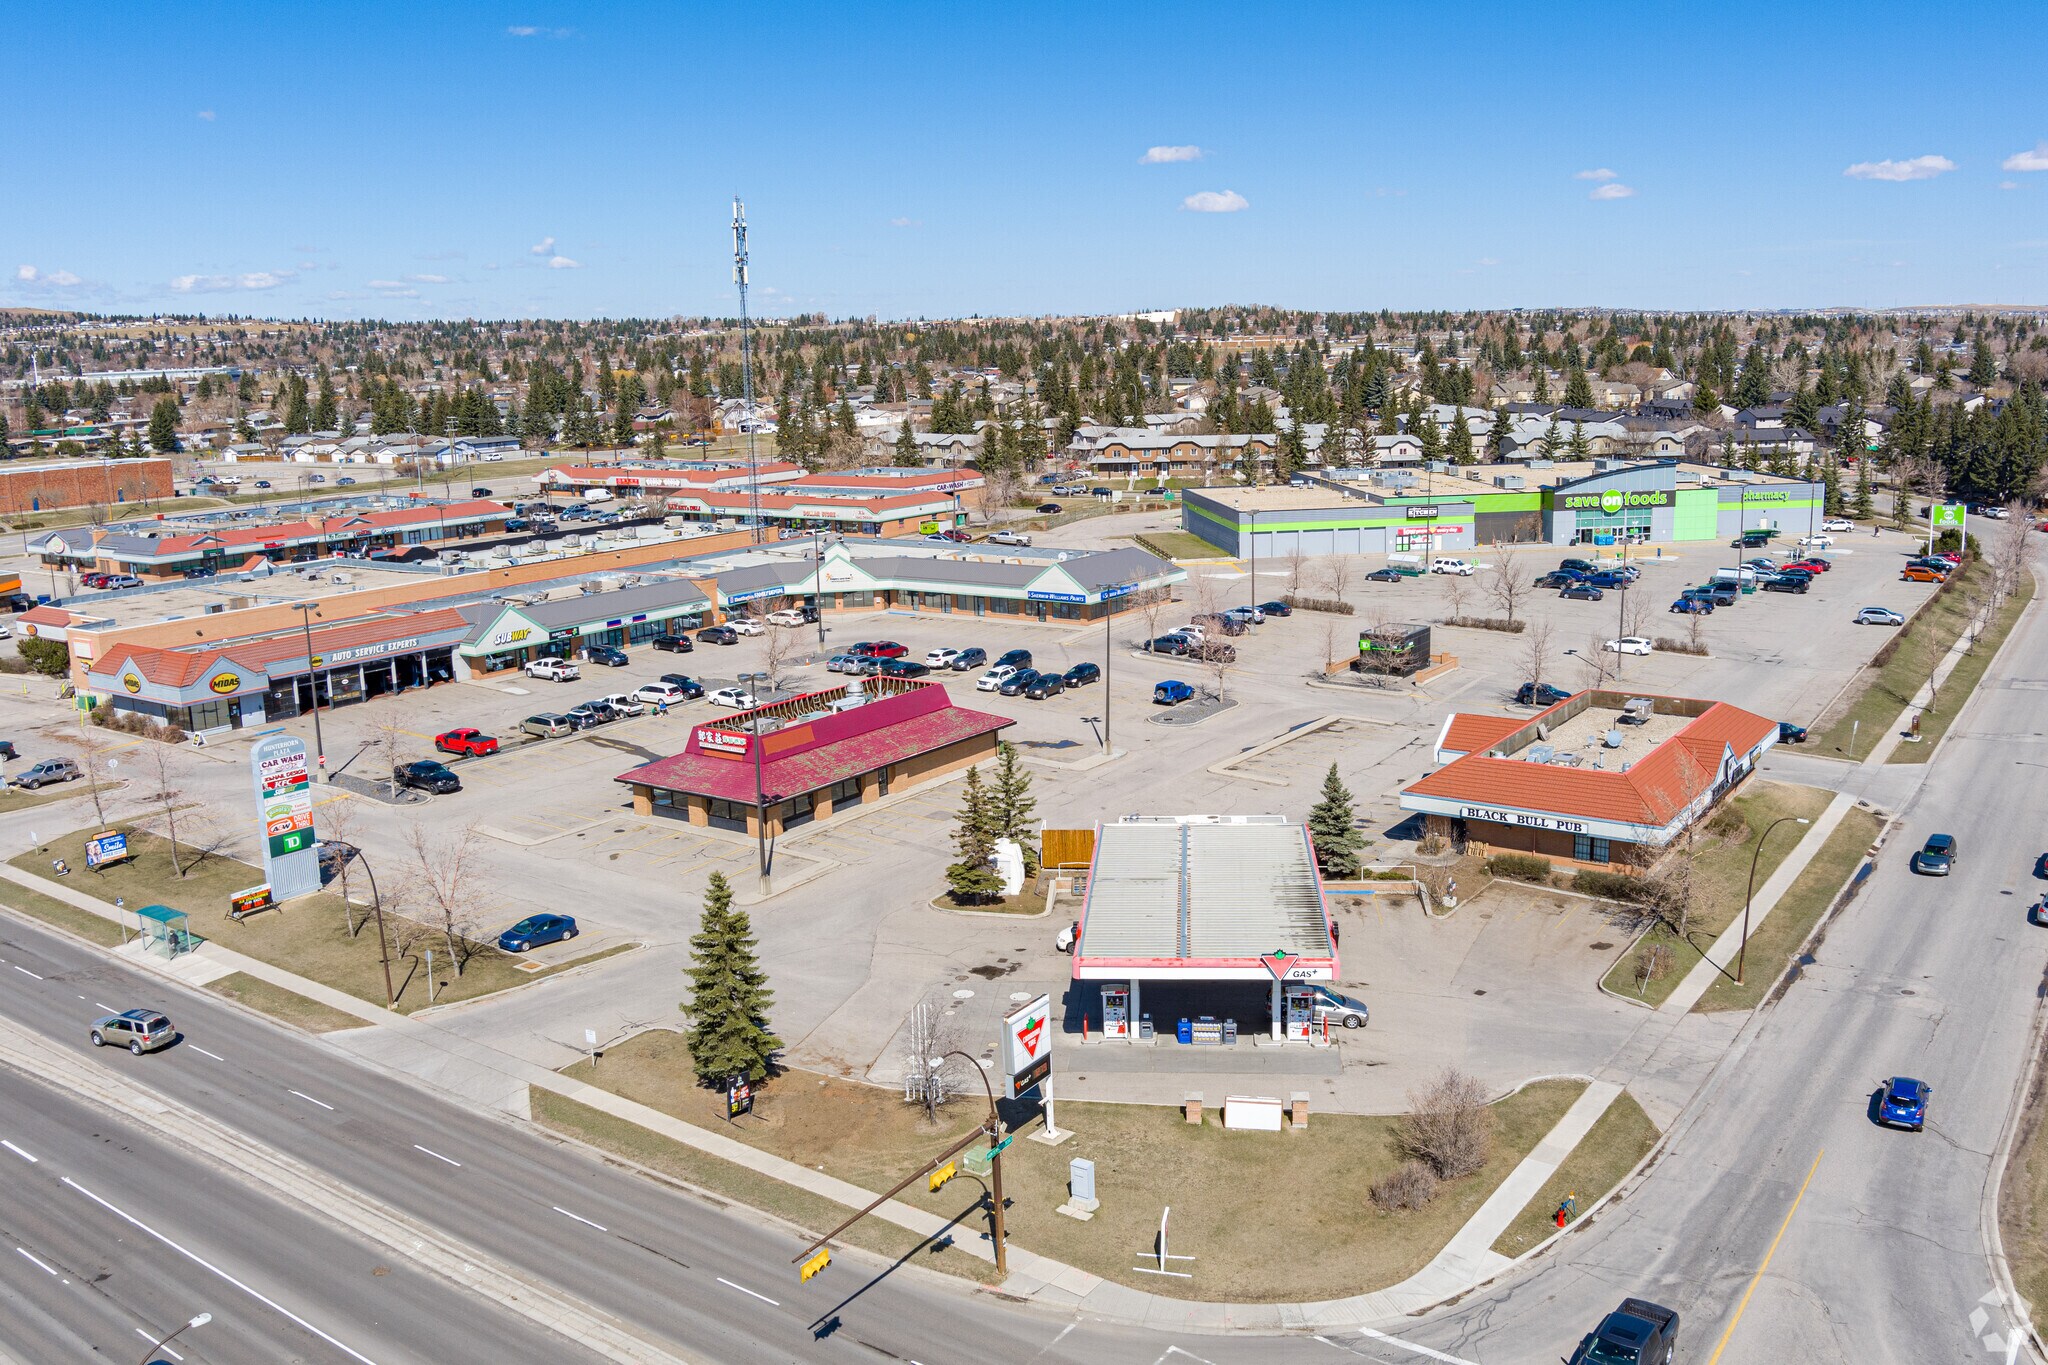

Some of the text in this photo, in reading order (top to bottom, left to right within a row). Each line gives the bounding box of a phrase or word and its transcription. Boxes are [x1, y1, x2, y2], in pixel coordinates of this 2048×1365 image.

[949, 481, 964, 489] WASH
[1565, 490, 1668, 508] save on foods
[1744, 491, 1790, 502] pharmacy
[495, 628, 531, 644] SUBWAY
[332, 638, 418, 662] AUTO SERVICE EXPERTS
[212, 678, 239, 688] MIDAS
[263, 740, 299, 752] HUNTERHORN
[273, 748, 290, 756] PLAZA
[261, 754, 304, 768] CAR WASH
[275, 779, 292, 788] KFC
[293, 813, 310, 822] DRIVE
[1467, 808, 1582, 832] BLACK BULL PUB
[295, 820, 309, 828] THRU
[103, 842, 123, 852] Smile
[285, 837, 300, 848] TD
[1028, 1038, 1037, 1047] TIRE
